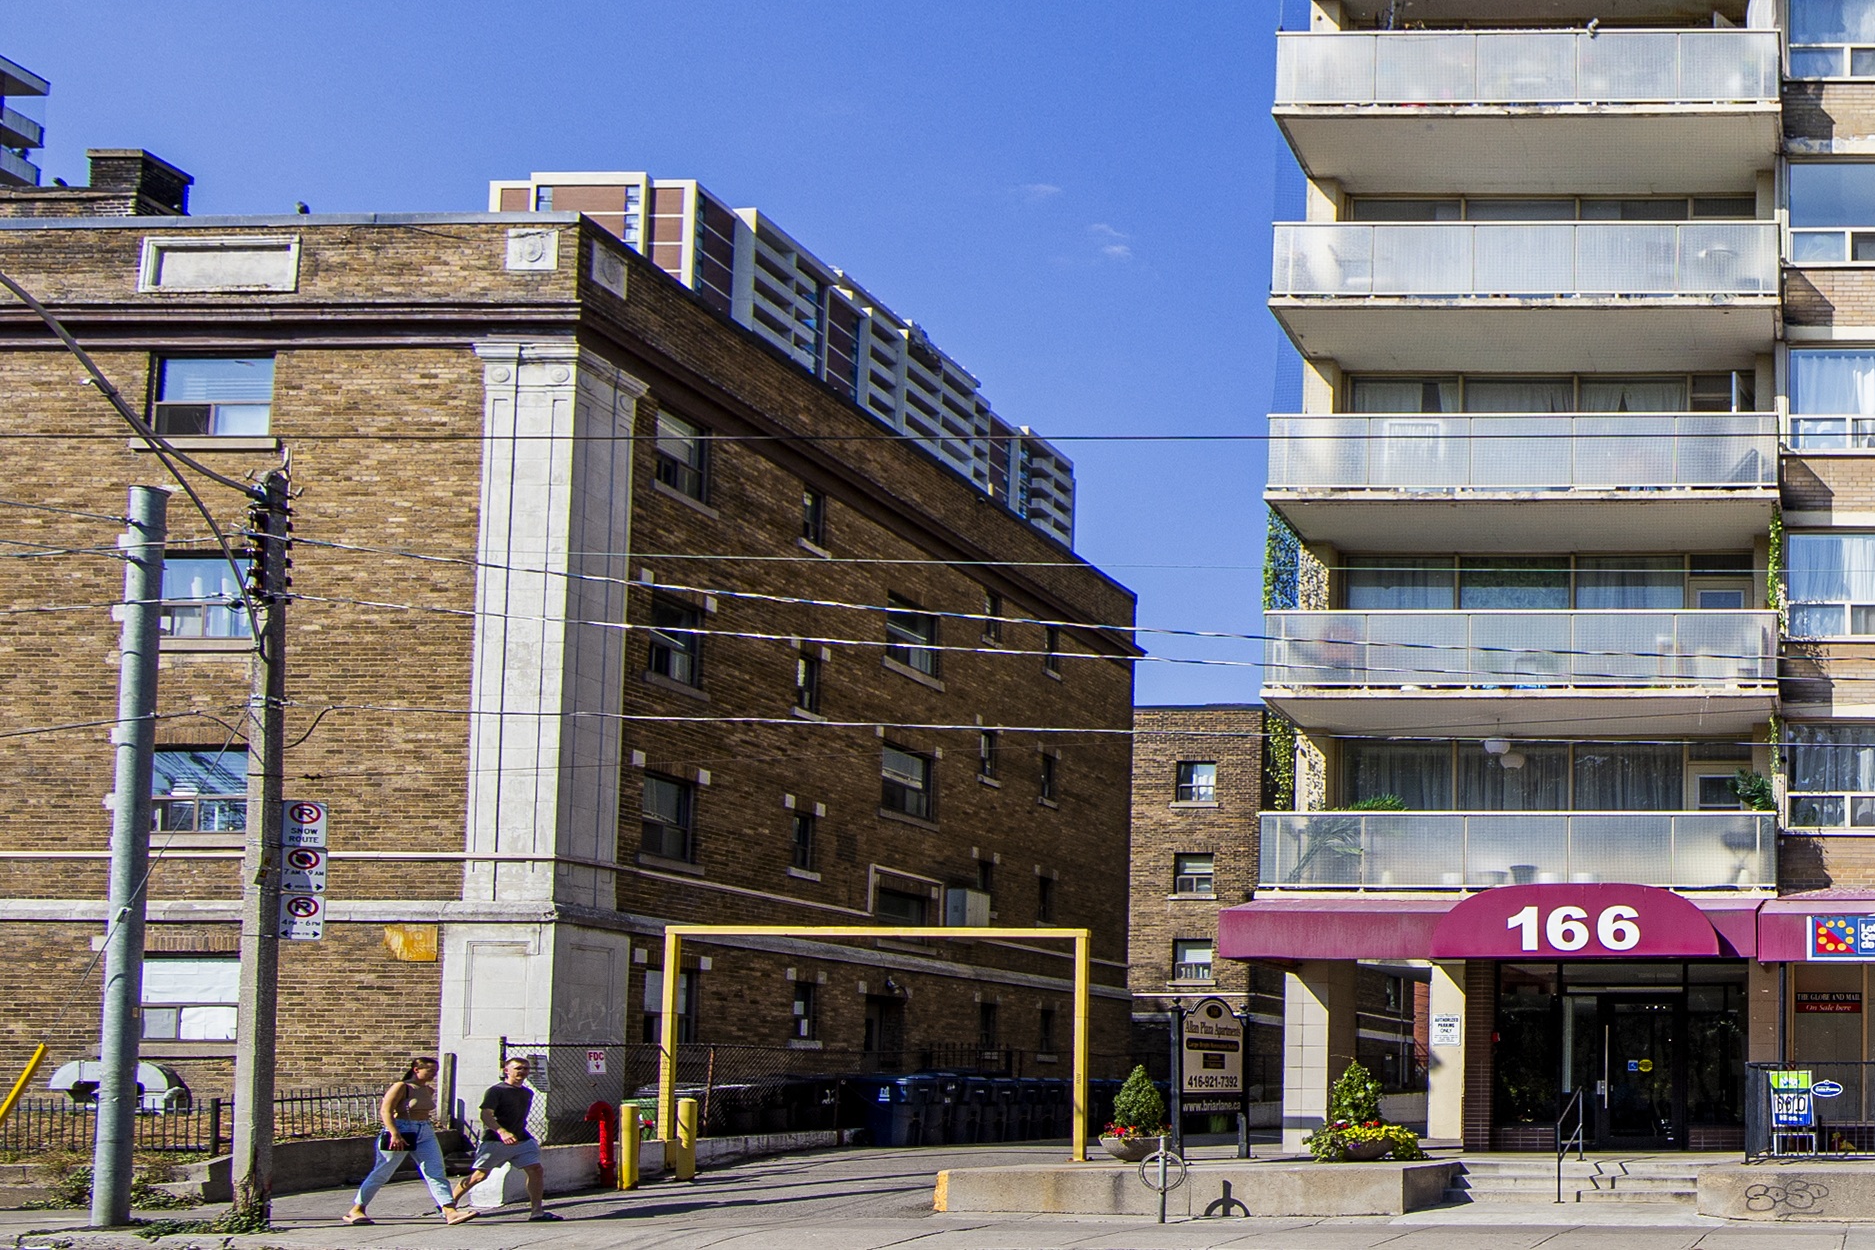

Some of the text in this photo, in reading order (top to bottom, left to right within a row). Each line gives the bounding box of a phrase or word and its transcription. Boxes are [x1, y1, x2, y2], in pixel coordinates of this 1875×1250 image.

[291, 827, 318, 835] SNOW
[289, 835, 319, 843] ROUTE
[1507, 905, 1641, 952] 166
[1860, 940, 1875, 949] de
[1797, 993, 1861, 1001] THE GLOBE AND MAIL
[1819, 1003, 1834, 1011] Sale
[1835, 1003, 1852, 1011] here
[588, 1051, 605, 1061] FDC
[1187, 1075, 1238, 1088] 416-921-7392
[1182, 1099, 1242, 1111] www.briarlane.ca
